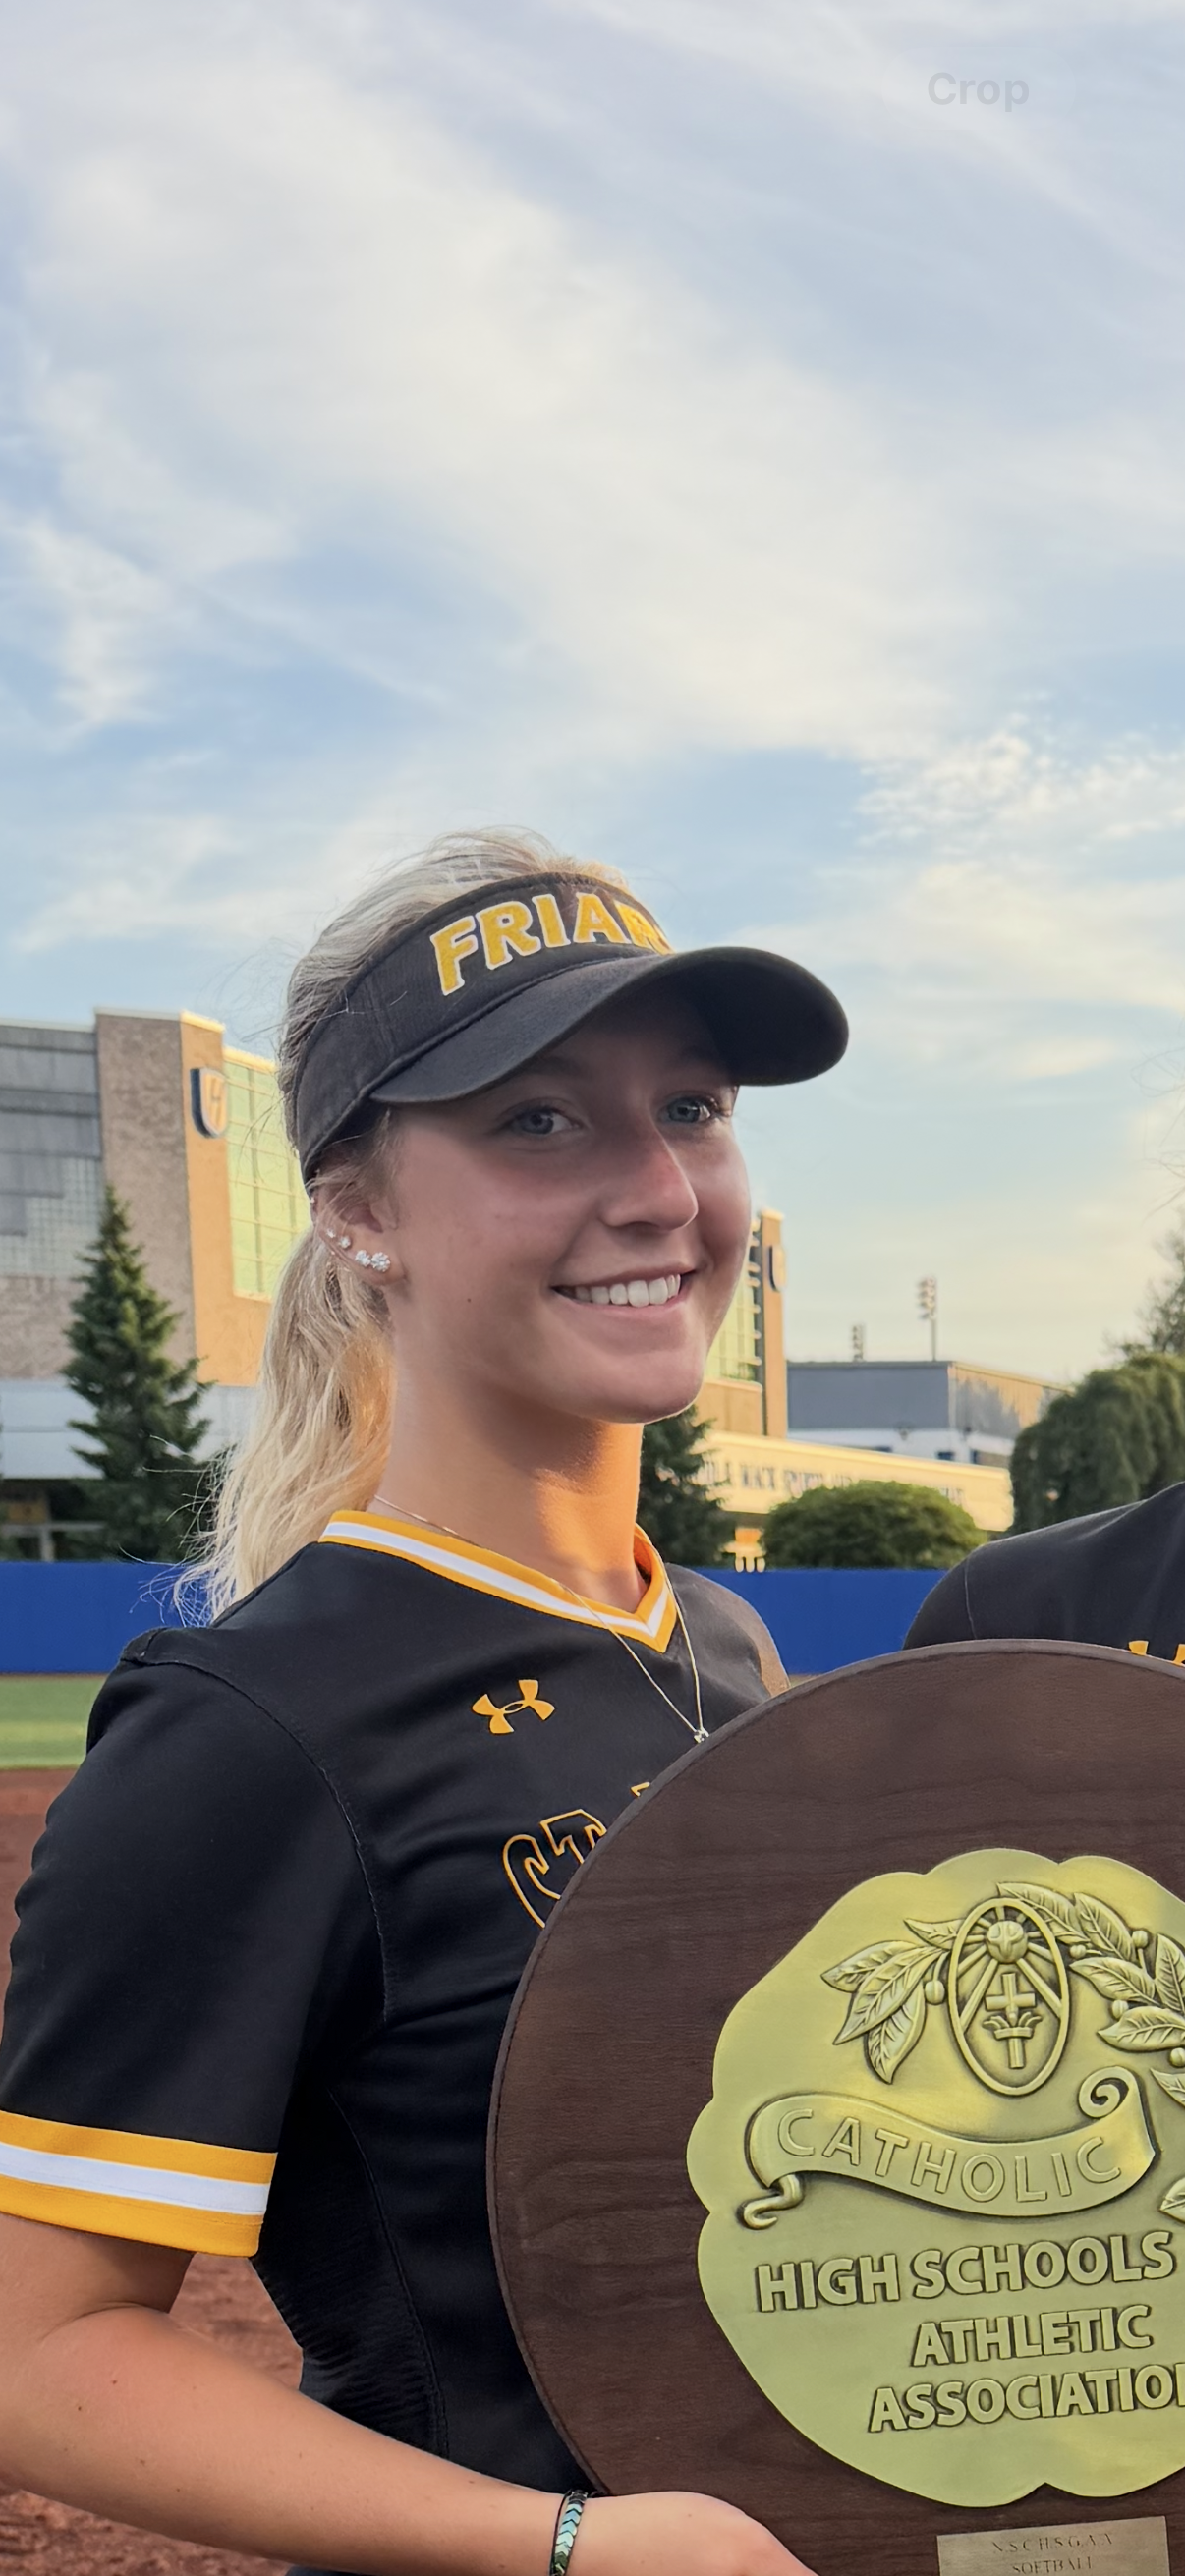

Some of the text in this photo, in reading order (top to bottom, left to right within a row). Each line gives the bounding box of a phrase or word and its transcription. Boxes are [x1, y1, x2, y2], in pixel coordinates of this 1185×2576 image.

[777, 2108, 1121, 2203] CATHOLIC
[757, 2231, 1175, 2313] HIGH SCHOOLS
[912, 2304, 1154, 2367] ATHLETIC
[868, 2361, 1185, 2433] ASSOCIATIO
